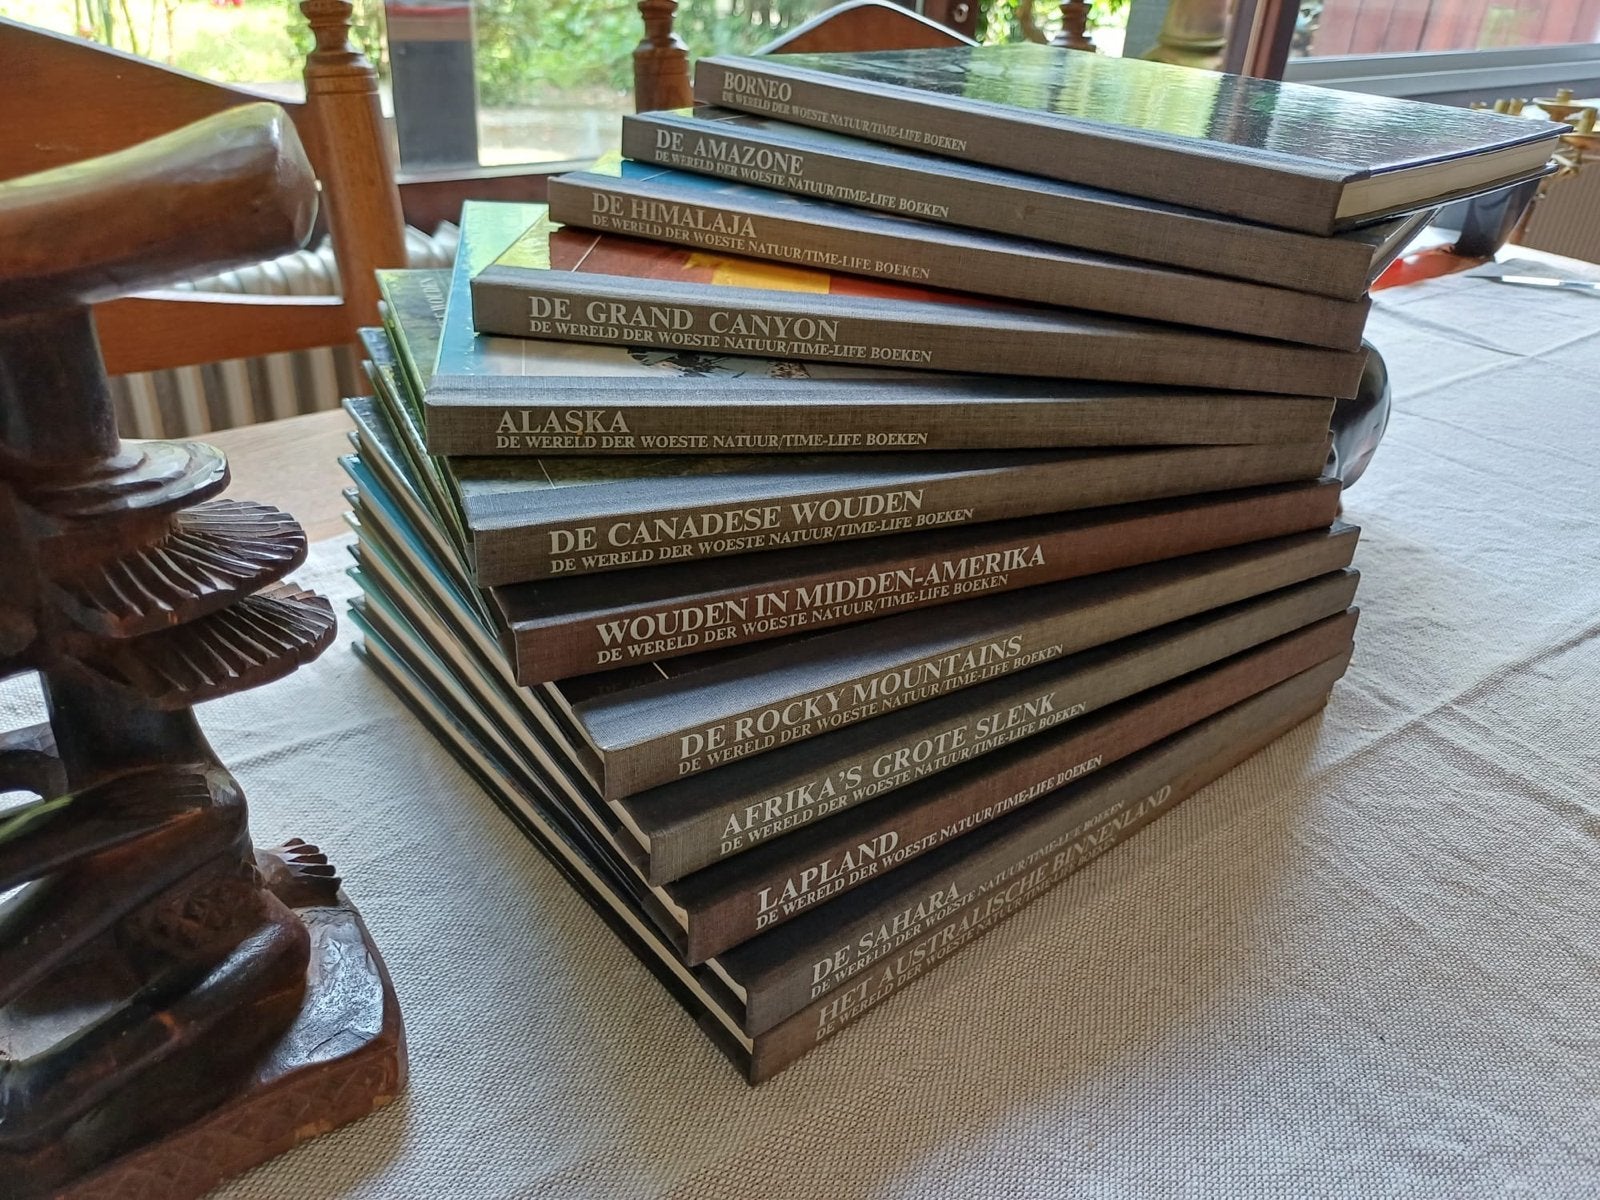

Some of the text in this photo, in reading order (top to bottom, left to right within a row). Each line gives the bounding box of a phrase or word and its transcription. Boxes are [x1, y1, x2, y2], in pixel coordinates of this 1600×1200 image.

[723, 71, 792, 101] BORNEO
[656, 129, 804, 176] DE AMAZONE
[722, 92, 735, 103] DE
[735, 94, 771, 112] WERELD
[772, 102, 790, 115] DER
[791, 105, 829, 124] WOESTE
[923, 132, 967, 151] BOEKEN
[592, 192, 757, 238] DE HIMALAJA
[655, 151, 950, 218] DE WERELD DER WOESTE NATUUR/TIME-LIFE BOEKEN
[592, 214, 930, 279] DE WERELD DER WOESTE NATUUR/TIME-LIFE BOEKEN
[528, 296, 839, 342] DE GRAND CANYON
[530, 320, 932, 363] DE WERELD DER WOESTE NATUUR/TIME-LIFE BOEKEN
[496, 432, 928, 450] DE WERELD DER WOESTE NATUUR/TIME-LIFE BOEKEN
[498, 410, 630, 434] ALASKA
[549, 489, 926, 555] DE CANADESE WOUDEN
[551, 508, 975, 573] DE WERELD DER WOESTE NATUUR/TIME-LIFE BOEKEN
[596, 543, 1046, 646] WOUDEN IN MIDDEN-AMERIKA
[597, 574, 1008, 664] DE WERELD DER WOESTE NATUUR/TIME-LIFE BOEKEN
[678, 644, 1063, 775] DE WERELD DER WOESTE NATUUR/TIME-LIFE BOEKEN
[680, 634, 1023, 759] DE ROCKY MOUNTAINS
[873, 726, 968, 778] GROTE
[975, 692, 1056, 740] SLENK
[720, 702, 1087, 856] DE WERELD DER WOESTE NATUUR/TIME-LIFE BOEKEN
[756, 754, 1103, 930] DE WERELD DER WOESTE NATUUR/TIME-LIFE BOEKEN
[757, 831, 899, 915] LAPLAND
[811, 881, 961, 986] DE SAHARA
[819, 784, 1172, 1028] HET AUSTRALISCHE BINNENLAND
[811, 978, 830, 999] DE
[835, 943, 891, 983] WERELD
[895, 923, 922, 947] DER
[925, 889, 976, 928] WOESTE
